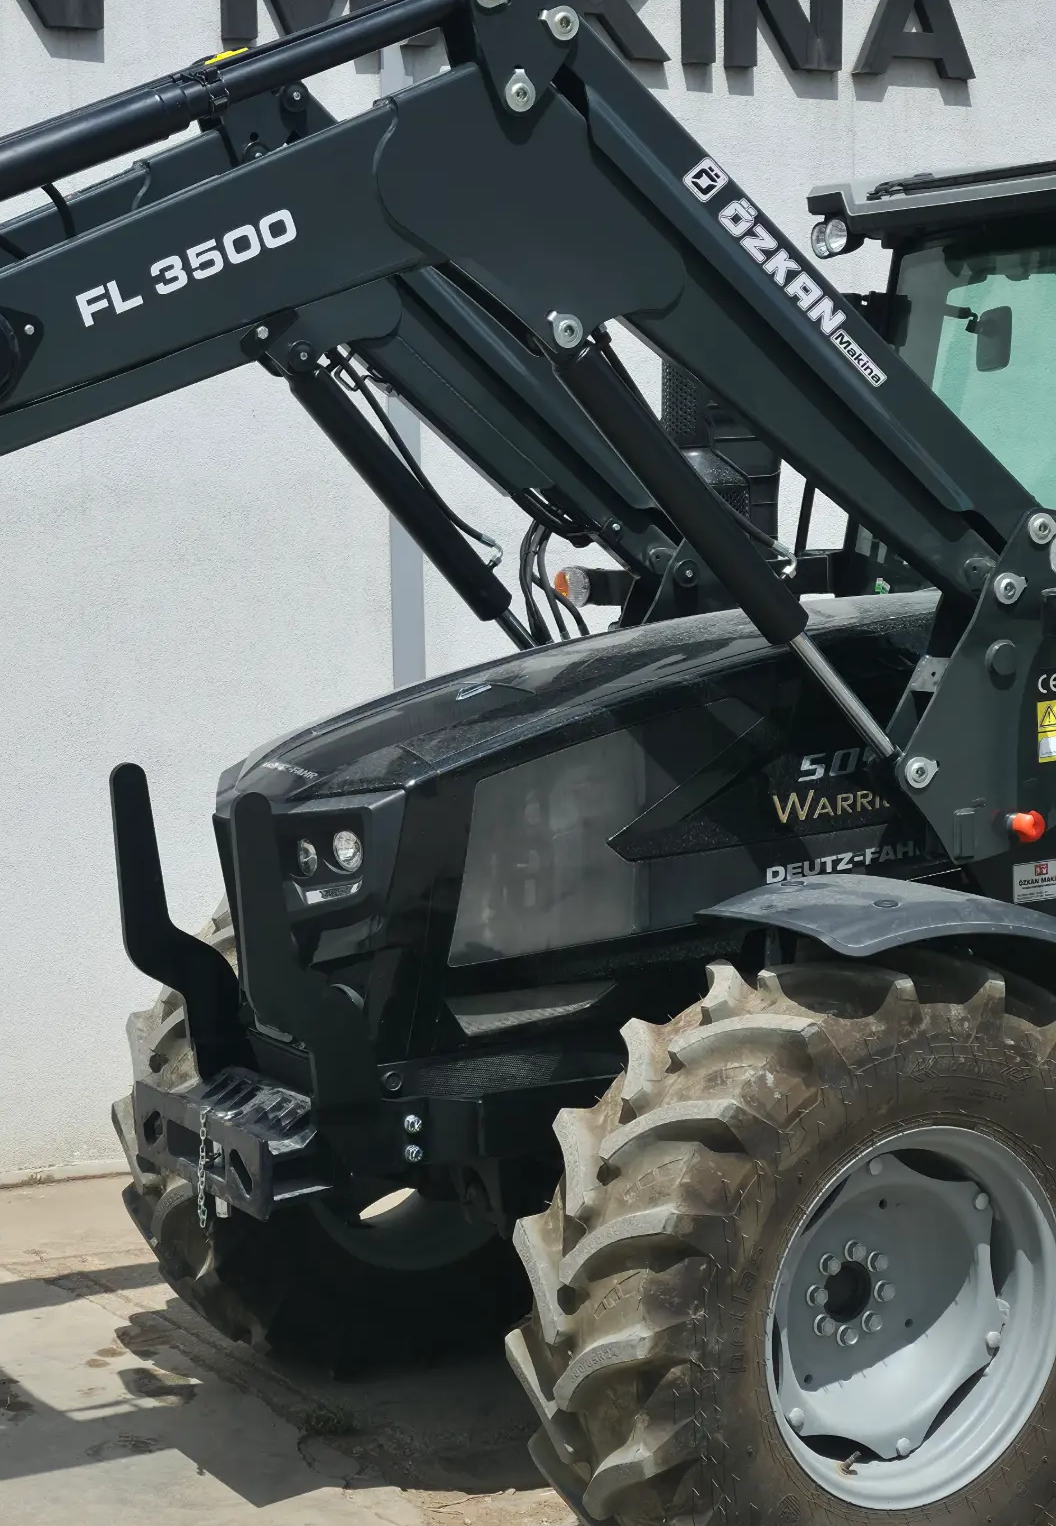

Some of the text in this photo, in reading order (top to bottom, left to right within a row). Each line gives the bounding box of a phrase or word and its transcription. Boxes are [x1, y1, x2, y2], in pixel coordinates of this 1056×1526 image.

[75, 208, 297, 327] FL 3500
[718, 197, 883, 385] ÖZKAN Makina
[766, 840, 921, 883] DEUTZ-FAH
